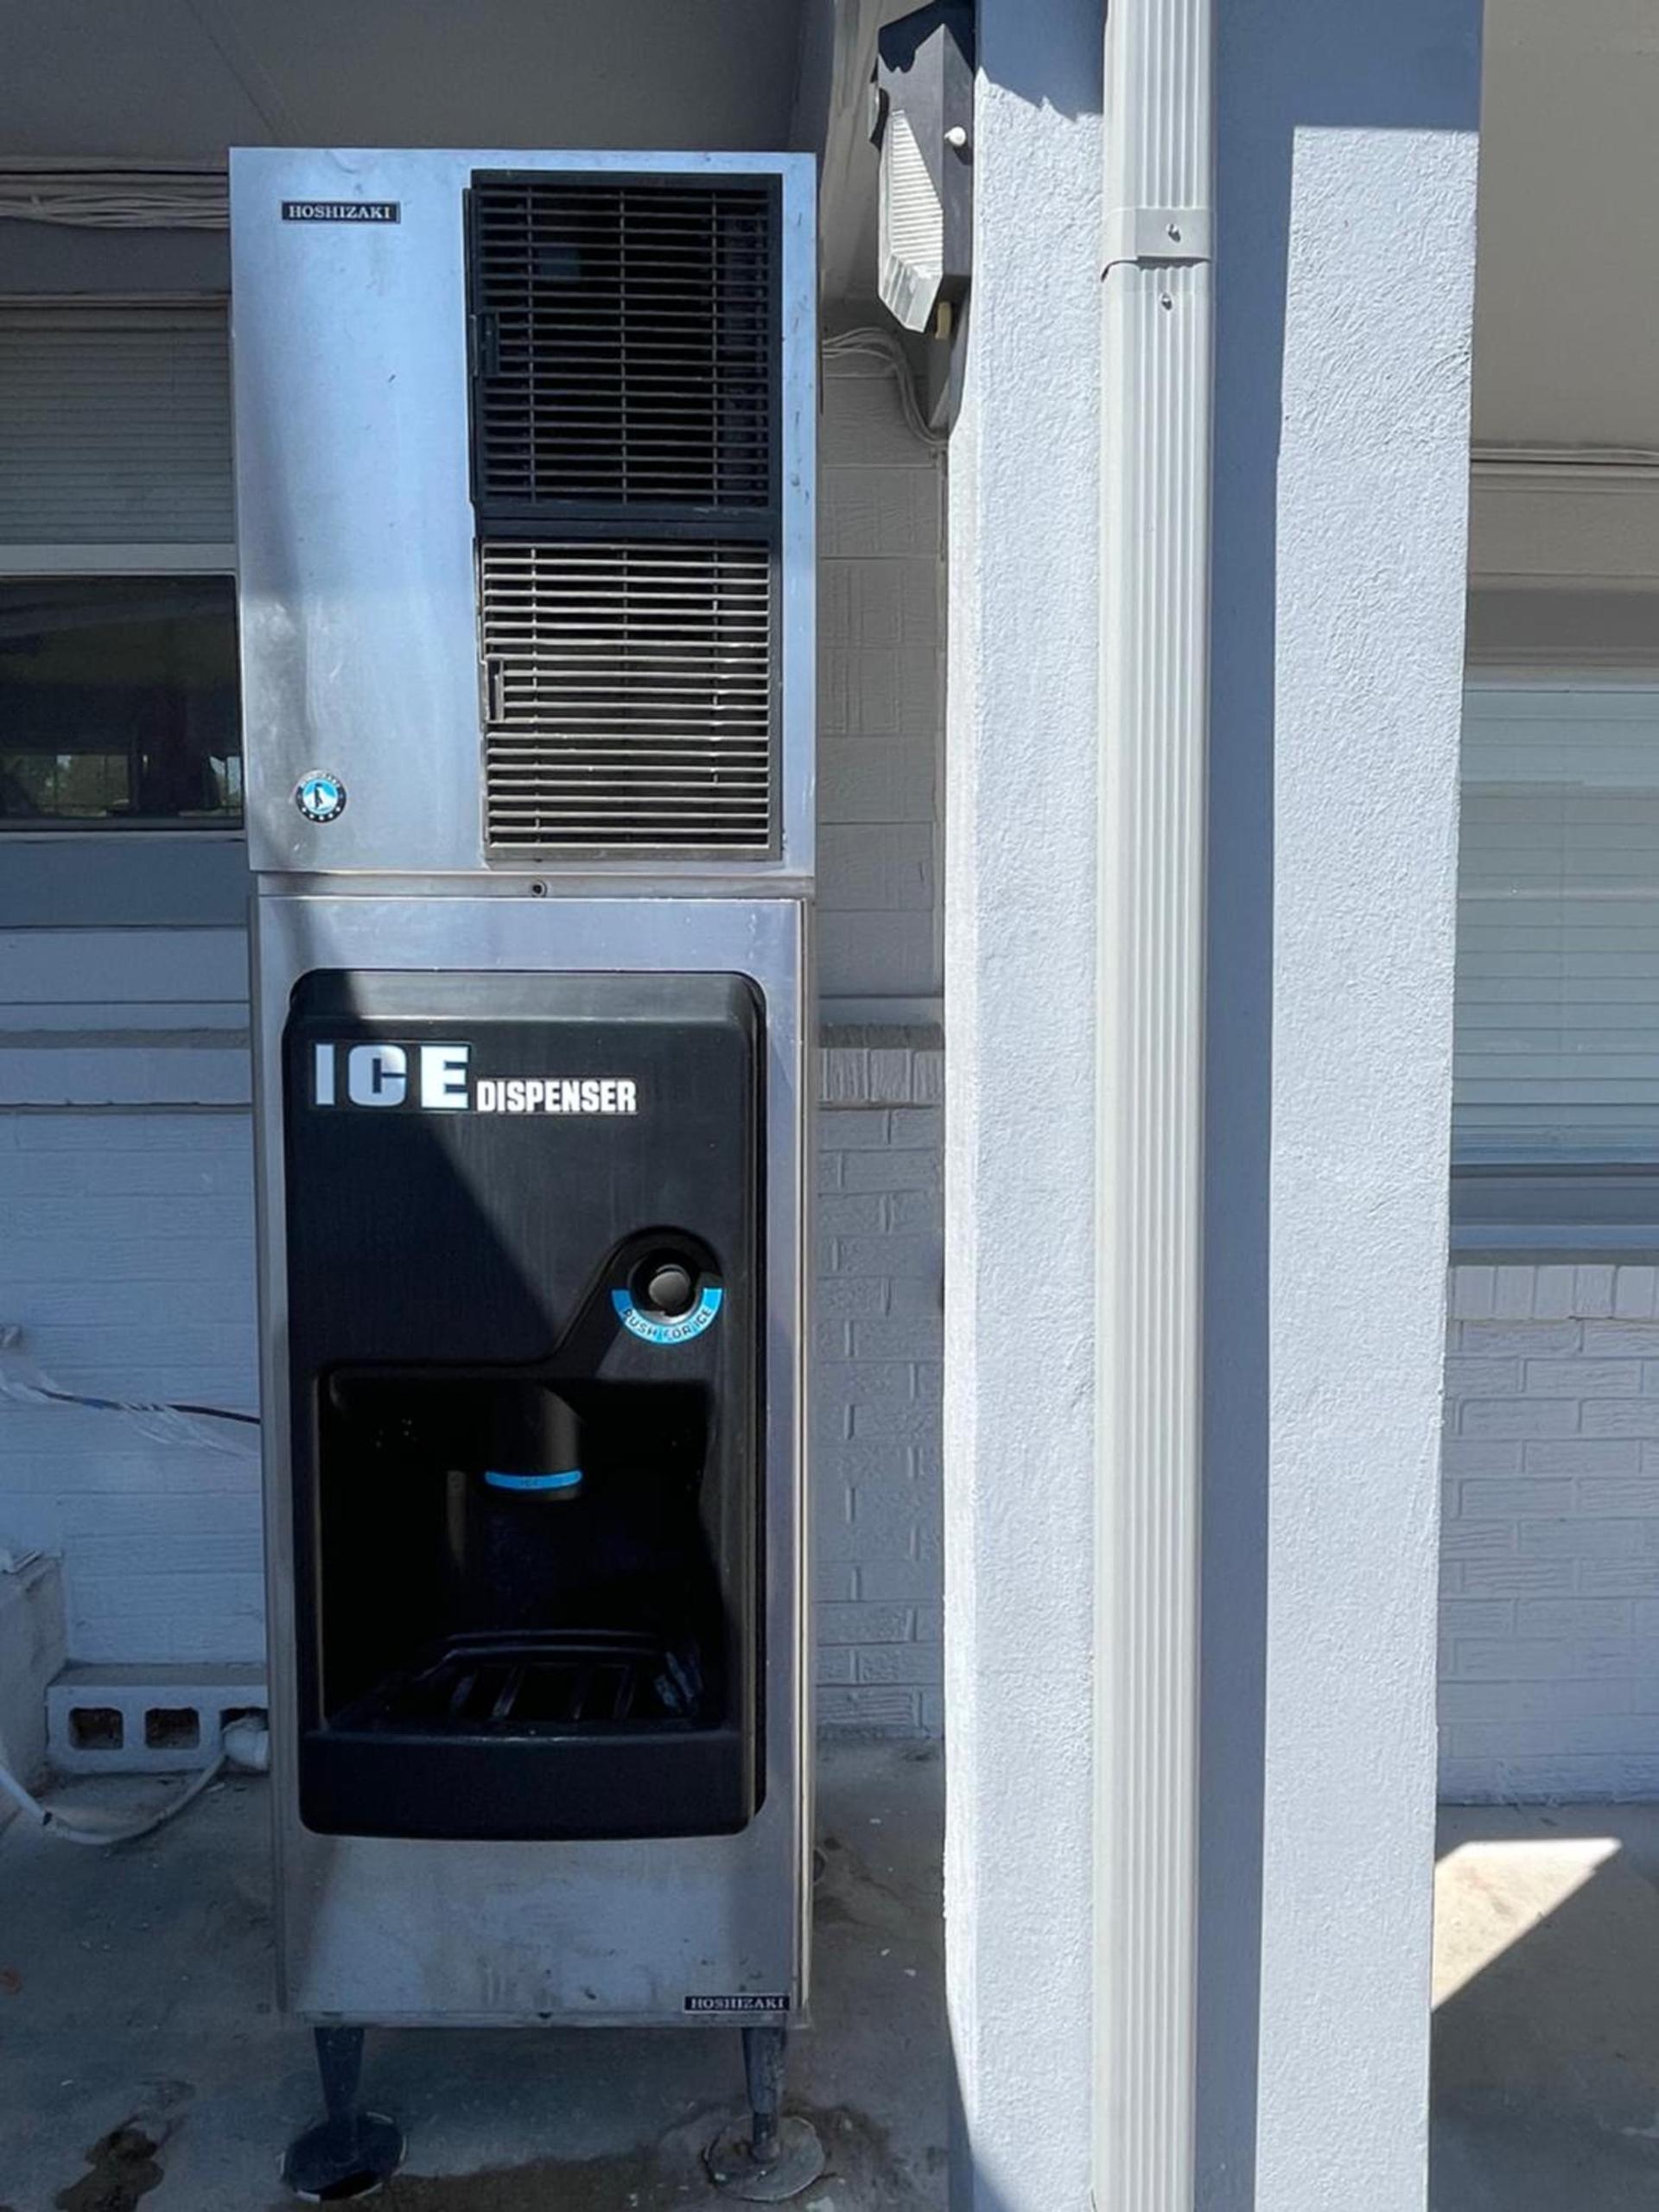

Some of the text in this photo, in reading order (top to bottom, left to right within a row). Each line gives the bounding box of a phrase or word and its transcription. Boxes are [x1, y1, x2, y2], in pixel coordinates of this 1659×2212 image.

[288, 204, 391, 219] HOSHIZAKI
[315, 1044, 637, 1112] ICE DISPENSER
[623, 1307, 657, 1338] PUSH
[693, 1306, 712, 1329] ICE
[691, 1997, 785, 2010] HOSHIZAKI
